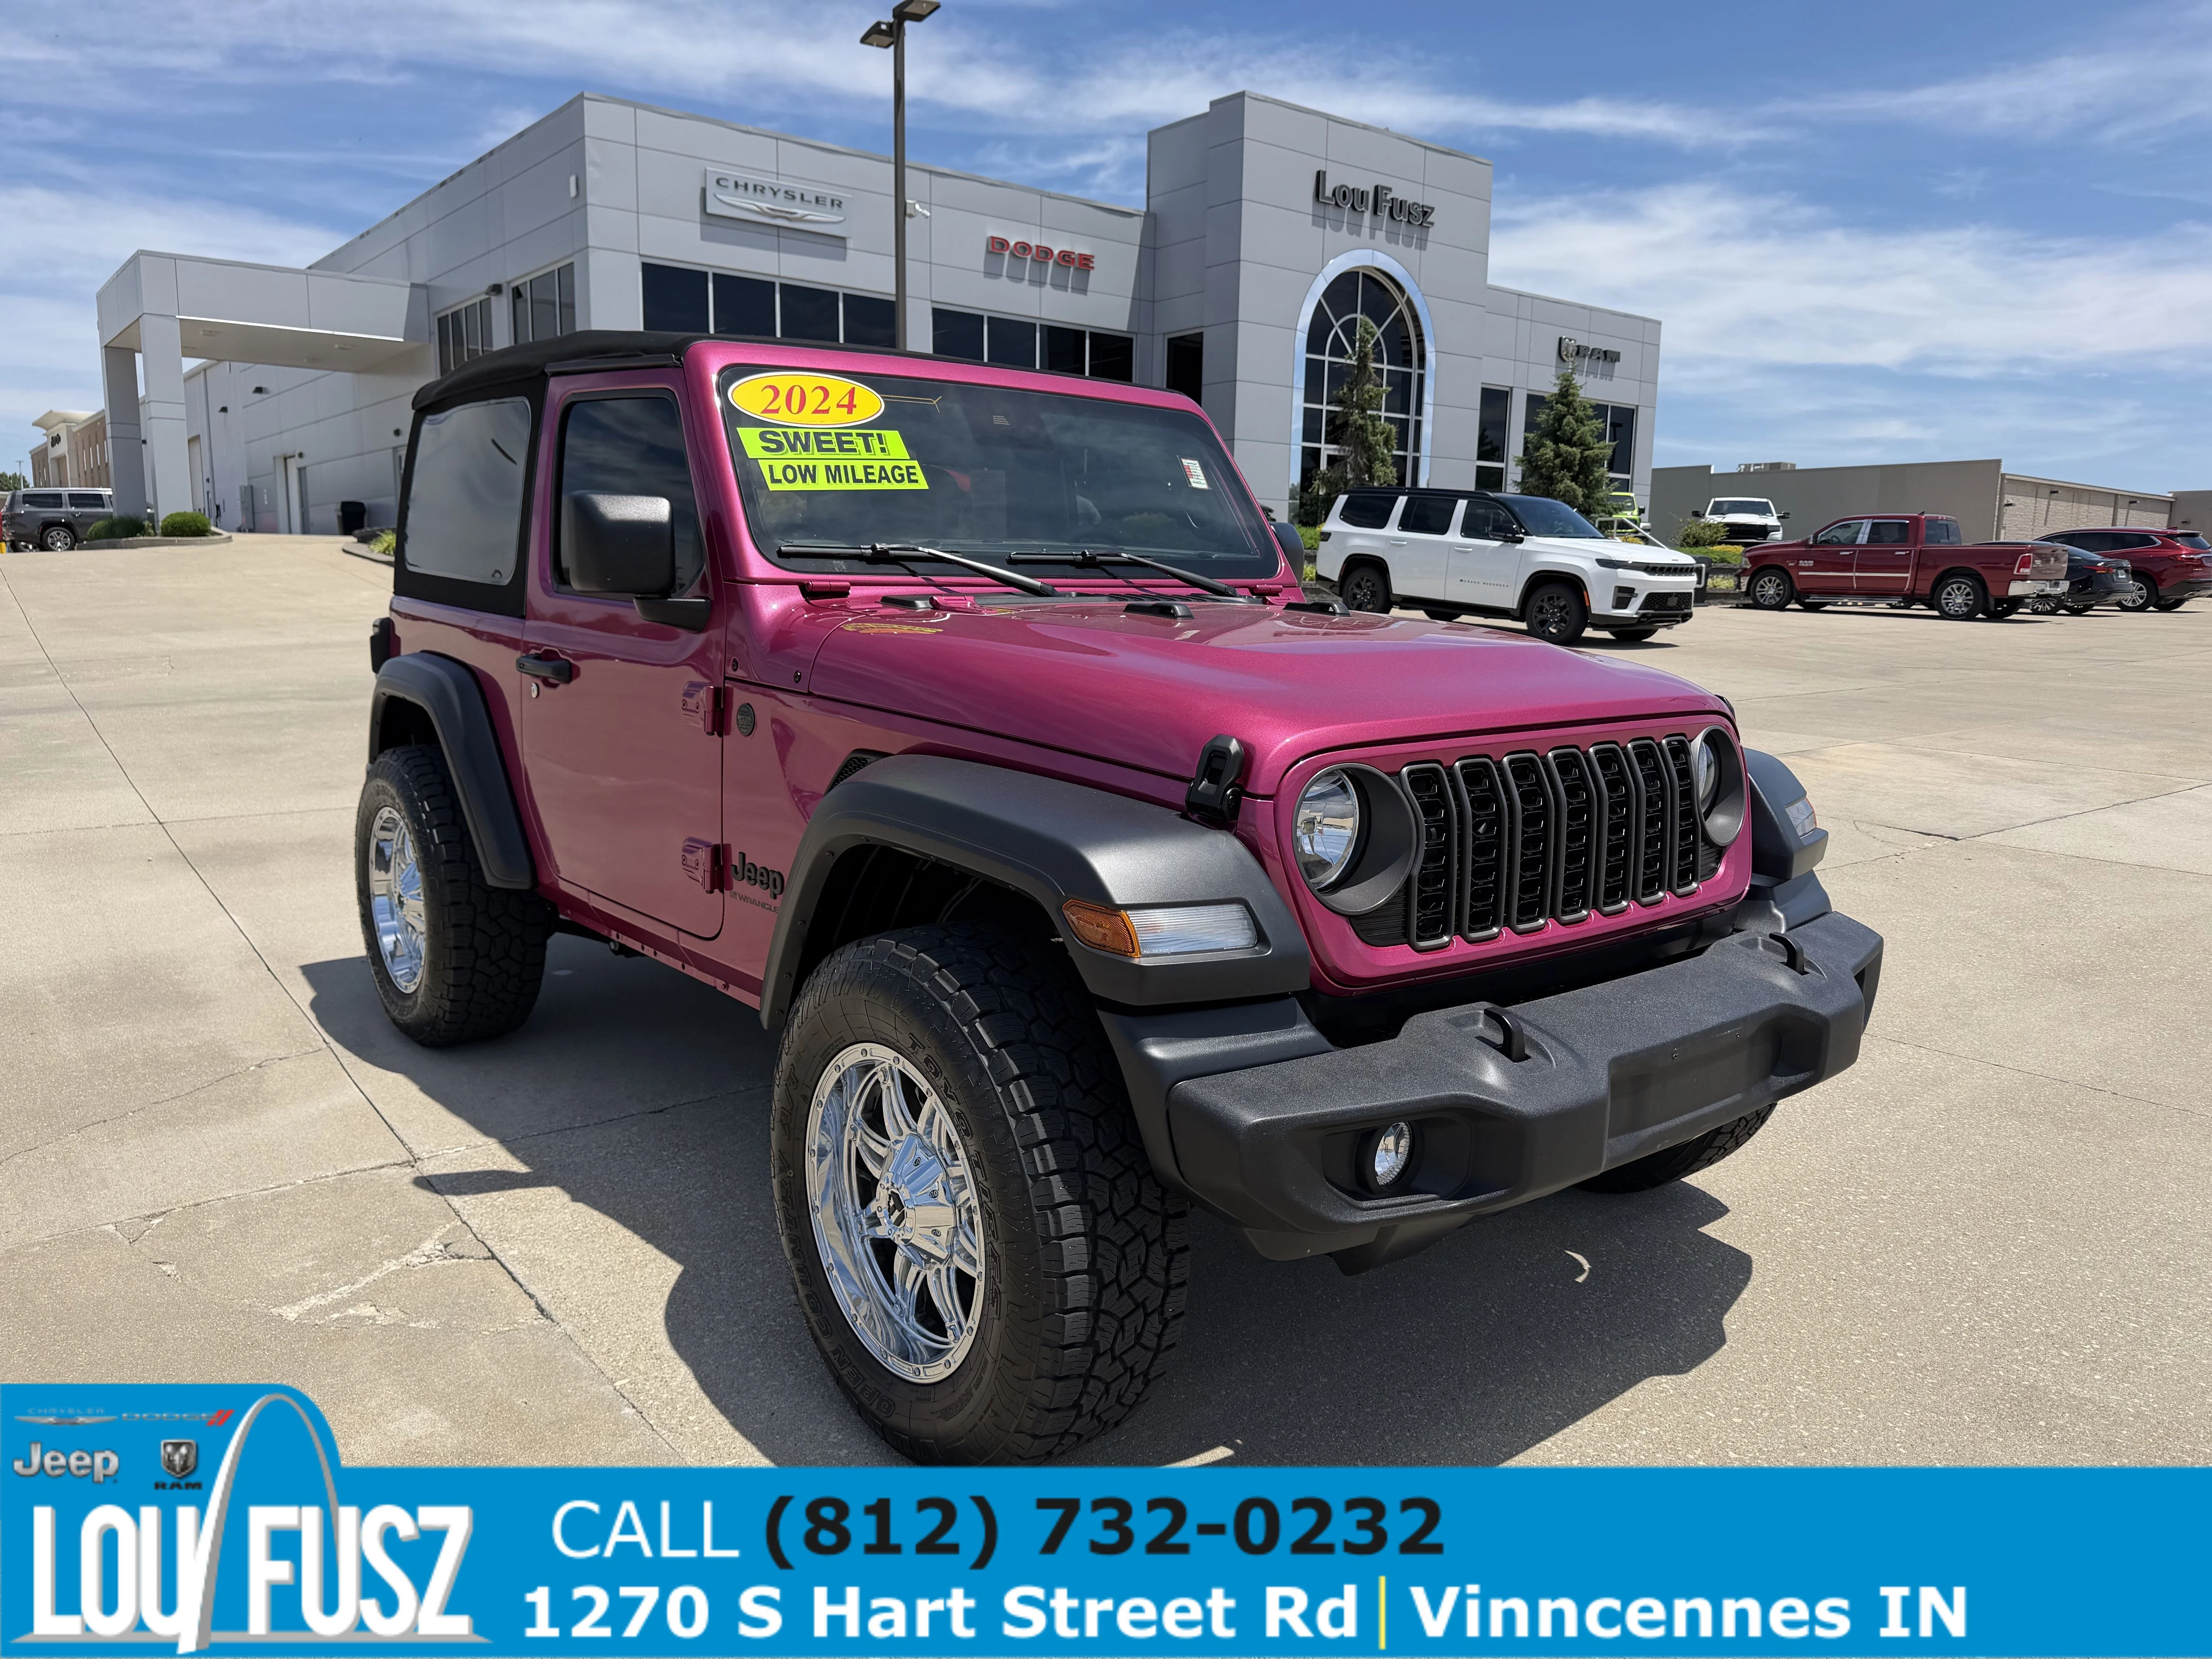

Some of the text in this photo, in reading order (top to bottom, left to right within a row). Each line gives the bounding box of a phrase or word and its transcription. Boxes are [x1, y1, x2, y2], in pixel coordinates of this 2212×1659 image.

[715, 177, 843, 210] CHRYSLER
[1316, 169, 1435, 227] Lou Fusz
[988, 235, 1095, 271] DODGE
[1576, 345, 1621, 362] RAM
[761, 385, 857, 415] 2024
[759, 430, 891, 456] SWEET!
[768, 464, 920, 485] LOW MILEAGE
[731, 852, 785, 900] Jeep
[737, 892, 780, 914] WRANGLE
[908, 1032, 974, 1140] TOYO
[830, 1343, 896, 1419] OPEN
